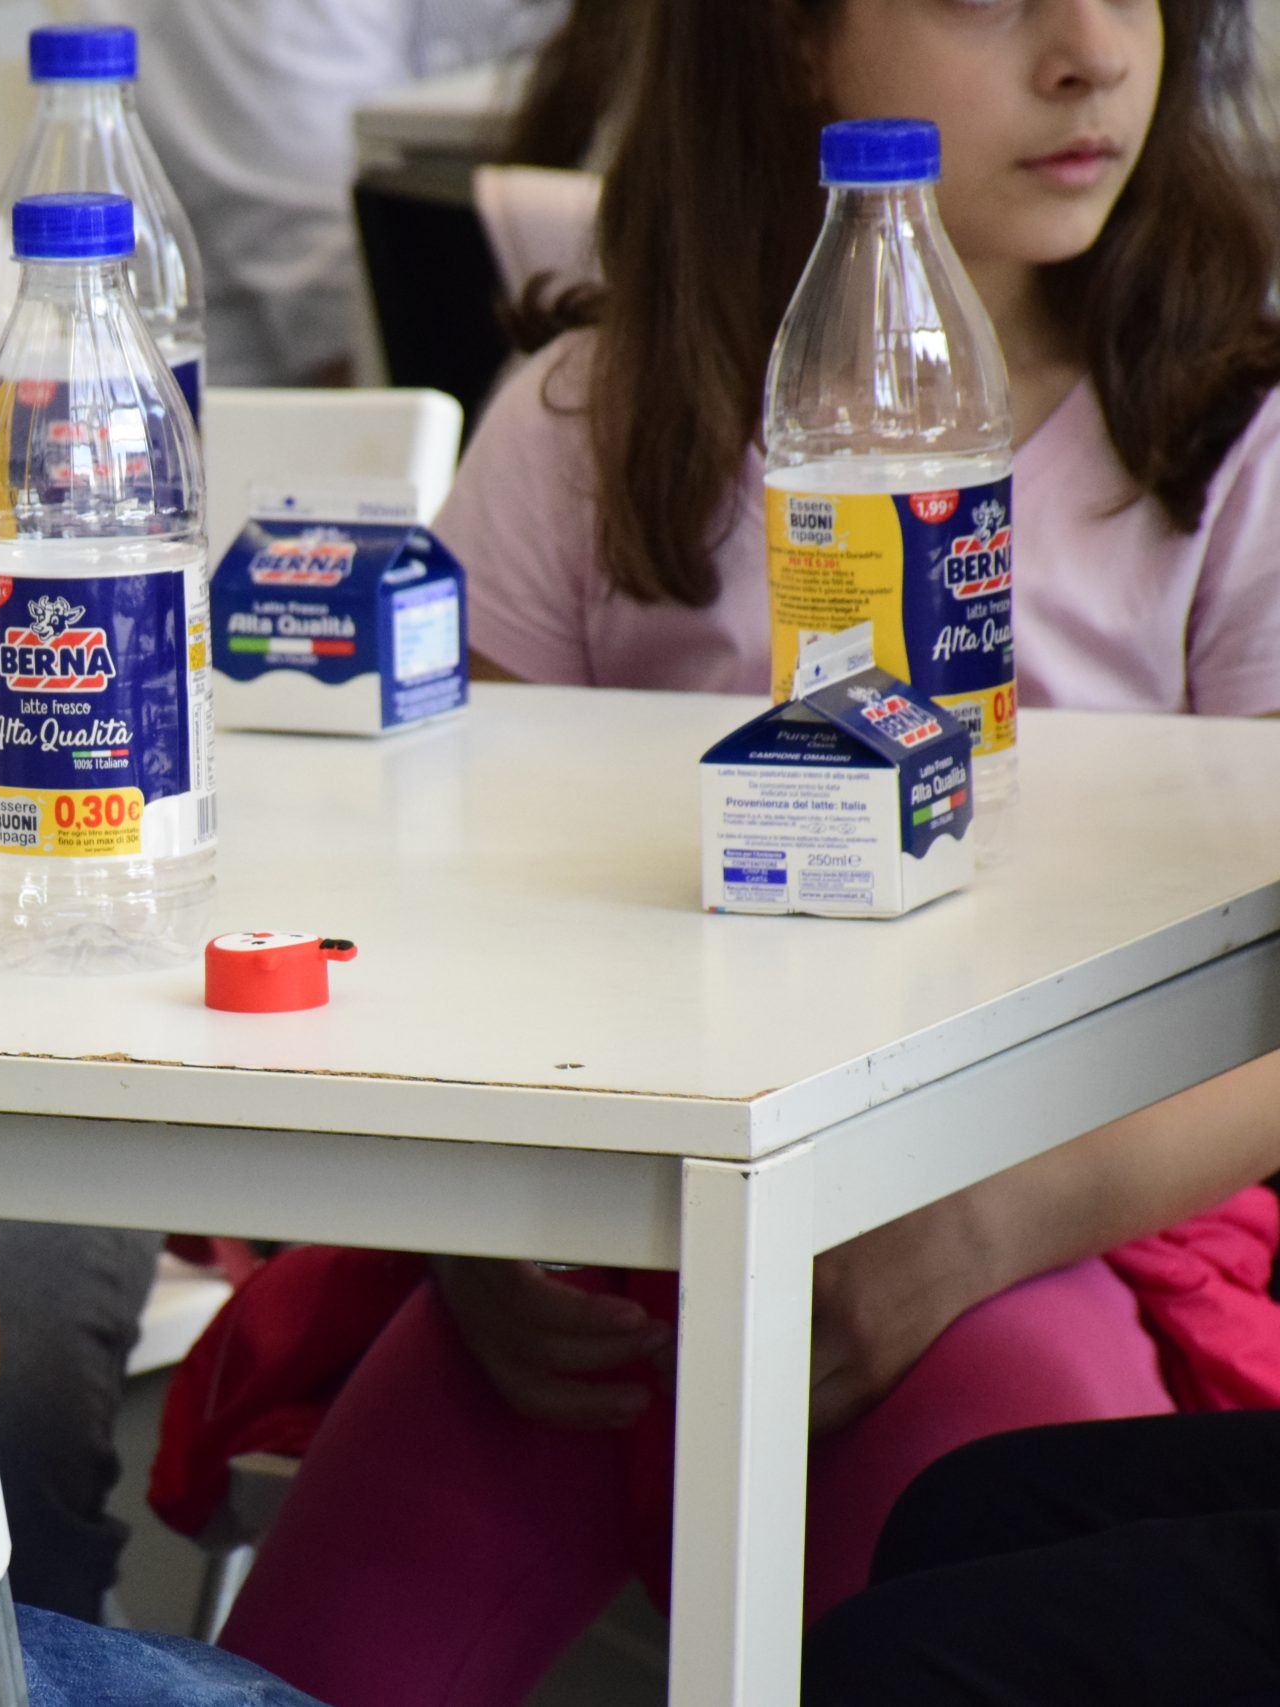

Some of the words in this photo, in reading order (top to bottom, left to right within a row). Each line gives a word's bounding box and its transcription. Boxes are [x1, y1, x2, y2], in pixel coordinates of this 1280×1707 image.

[790, 497, 833, 513] Essere
[790, 513, 833, 529] BUONI
[791, 530, 833, 545] ripaga
[253, 554, 352, 573] BERNA
[947, 546, 1012, 586] BERN
[228, 612, 273, 634] Alta
[277, 614, 356, 637] Qualità
[933, 624, 981, 661] Alta
[0, 644, 113, 679] BERNA
[20, 698, 47, 714] latte
[52, 698, 91, 715] fresco
[39, 718, 133, 752] Qualità
[73, 758, 93, 770] 100%
[95, 757, 129, 769] Italiano
[748, 750, 801, 761] CAMPIONE
[802, 752, 852, 762] OMAGGIO
[912, 782, 932, 806] Alta
[933, 761, 967, 796] Qualità
[726, 797, 790, 809] Provenienza
[792, 799, 808, 809] del
[811, 800, 838, 811] latte:
[841, 801, 867, 811] Italia
[58, 837, 74, 847] fino
[76, 839, 82, 847] a
[83, 838, 95, 847] un
[96, 837, 114, 847] max
[116, 835, 124, 844] di
[807, 854, 847, 867] 250ml
